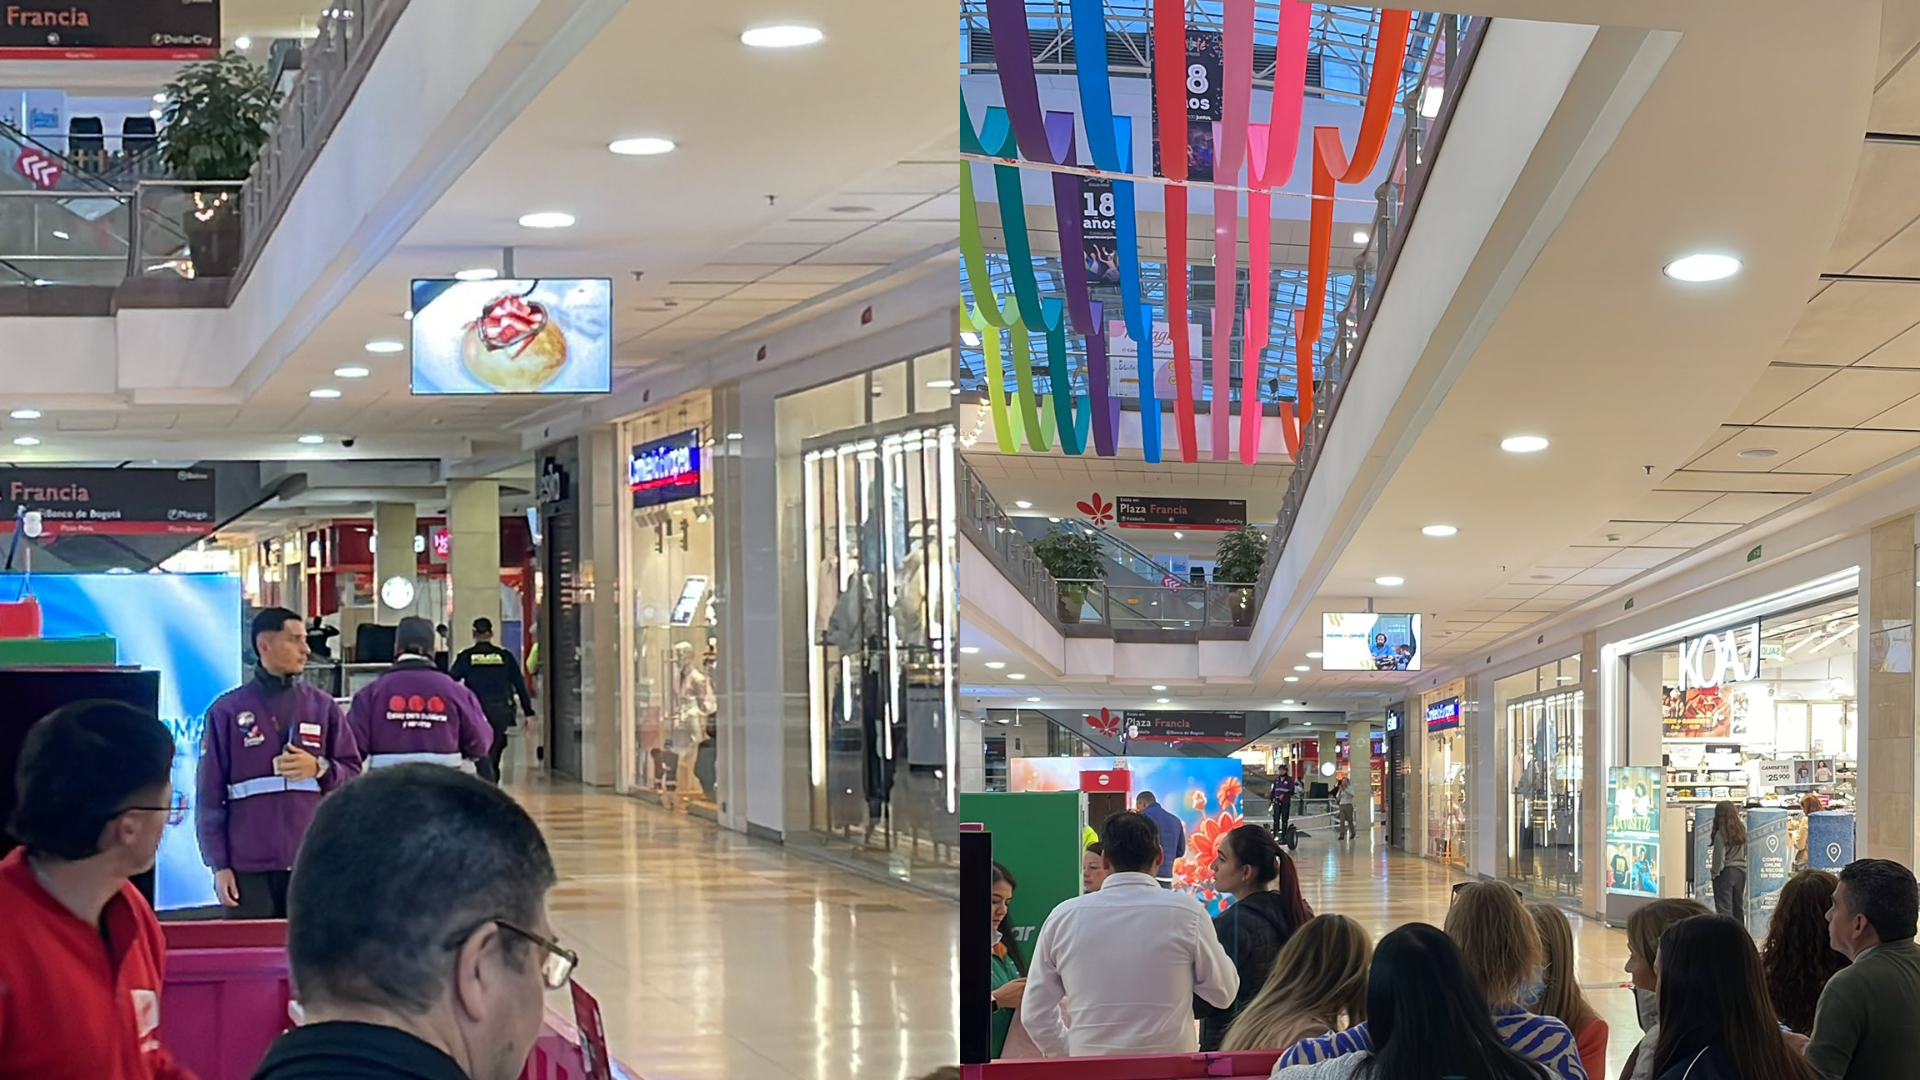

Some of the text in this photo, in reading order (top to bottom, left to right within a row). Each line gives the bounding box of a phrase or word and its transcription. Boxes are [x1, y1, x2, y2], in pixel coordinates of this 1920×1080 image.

[7, 6, 89, 27] Francia
[1186, 63, 1209, 94] 8
[1186, 97, 1210, 110] os
[1083, 192, 1115, 217] 18
[1083, 217, 1116, 229] años
[10, 481, 89, 501] Francia
[46, 508, 121, 520] Banco de Bogotá
[1120, 504, 1188, 515] Plaza Francia
[1679, 622, 1759, 692] KOAJ
[1126, 716, 1190, 728] Plaza Francia
[1012, 926, 1036, 941] ar
